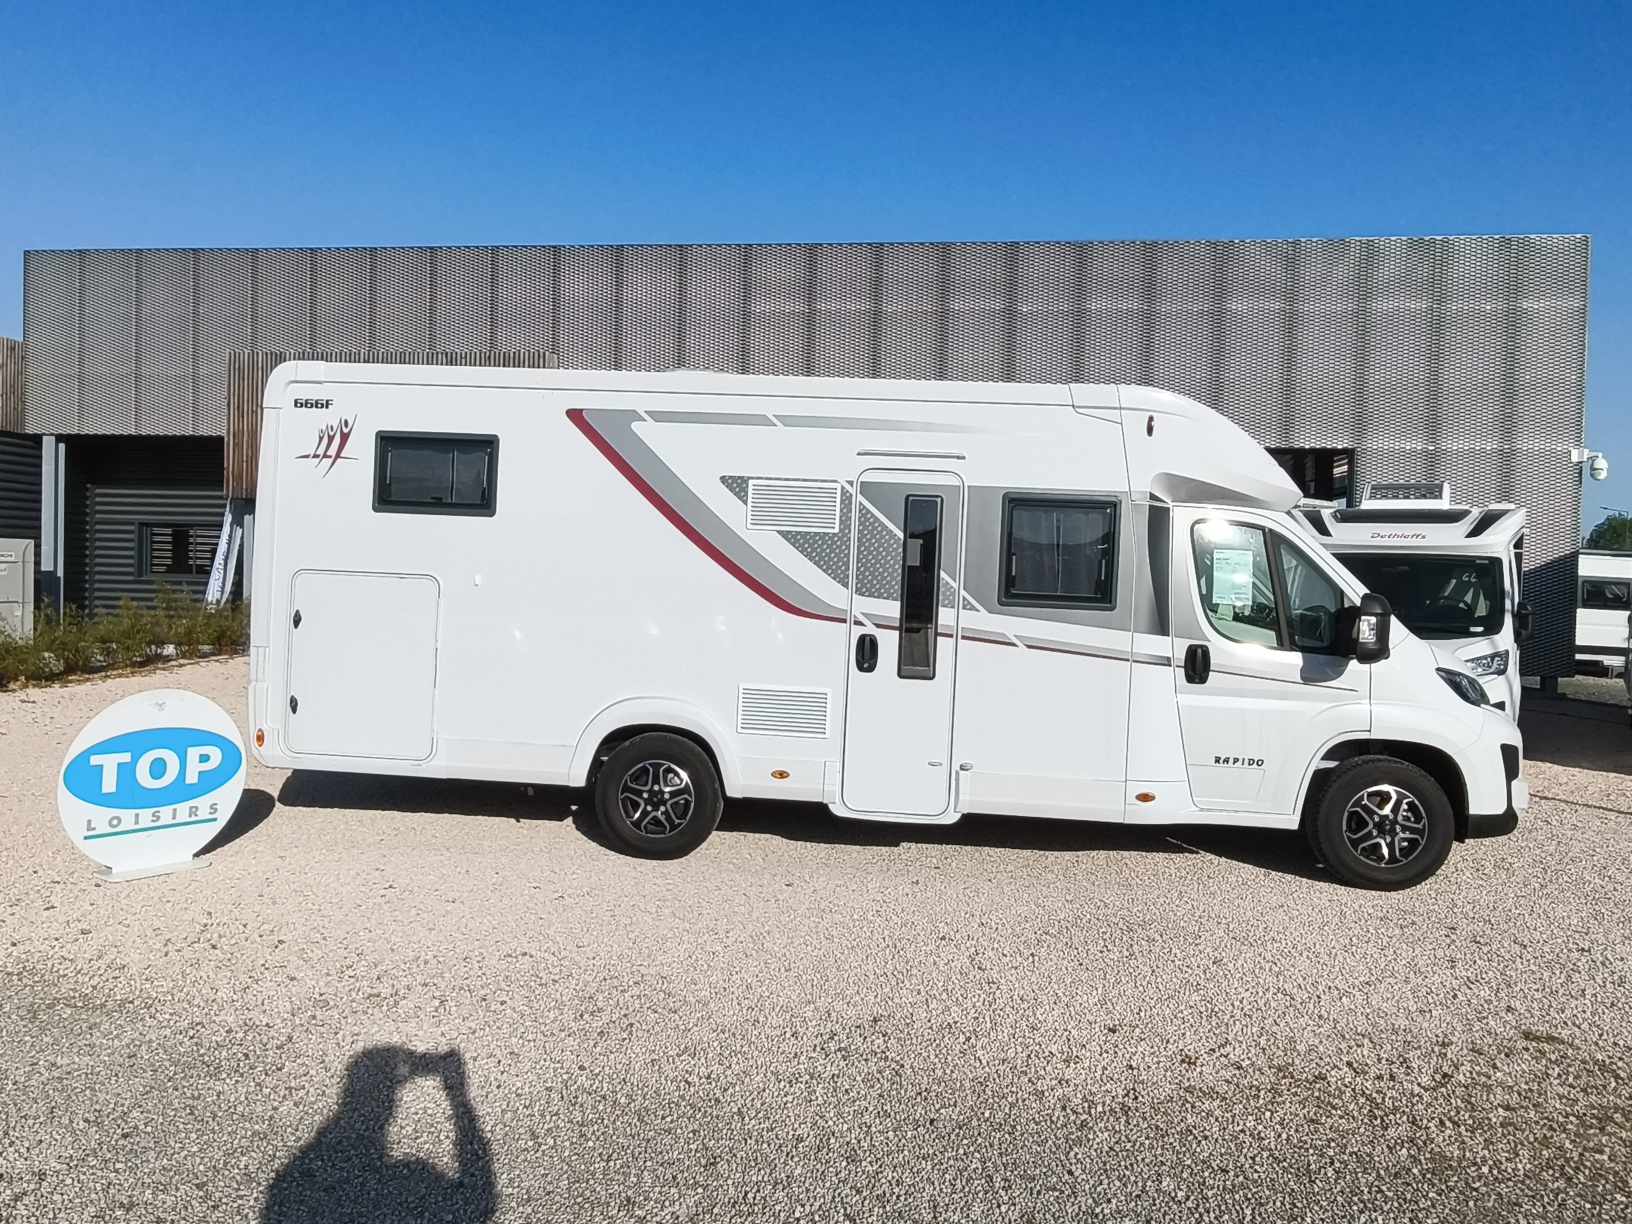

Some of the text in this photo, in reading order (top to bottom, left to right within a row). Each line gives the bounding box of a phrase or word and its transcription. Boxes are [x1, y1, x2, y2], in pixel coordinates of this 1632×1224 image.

[294, 398, 334, 409] 666F
[89, 745, 223, 794] TOP
[1214, 755, 1265, 767] RAPIDO
[85, 802, 220, 832] LOISIRS
